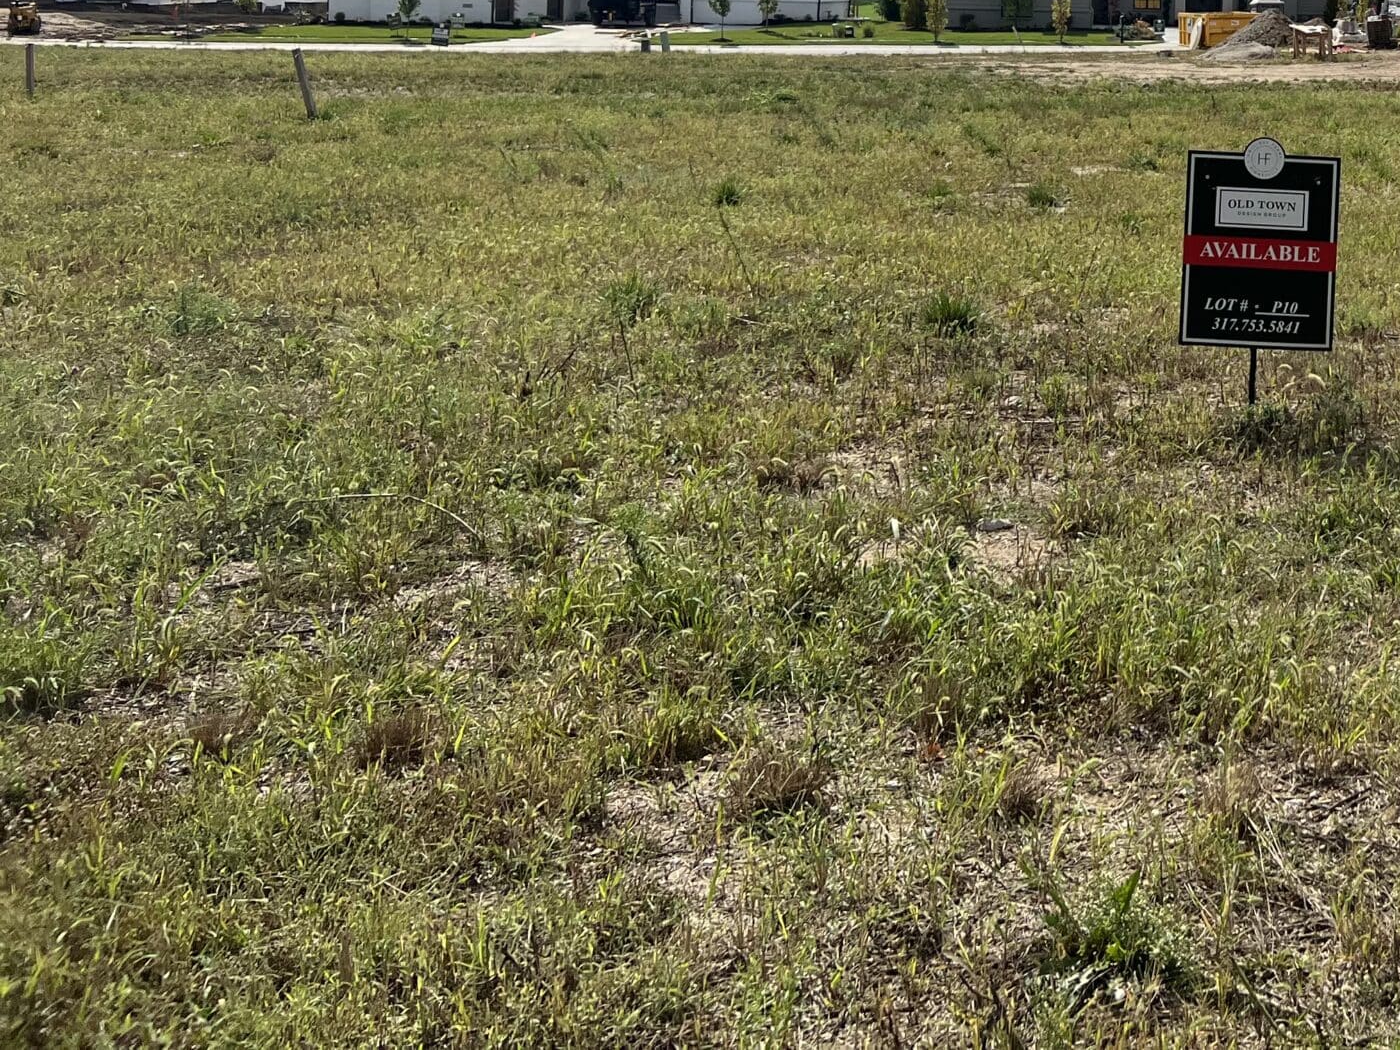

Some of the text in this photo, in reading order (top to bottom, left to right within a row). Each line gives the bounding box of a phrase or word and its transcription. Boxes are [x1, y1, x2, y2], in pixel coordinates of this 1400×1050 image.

[1227, 198, 1297, 212] OLD TOWN
[1199, 241, 1321, 263] AVAILABLE
[1203, 297, 1238, 311] LOT
[1239, 299, 1249, 312] #
[1271, 300, 1299, 314] P10
[1211, 317, 1300, 334] 317.753.5841
